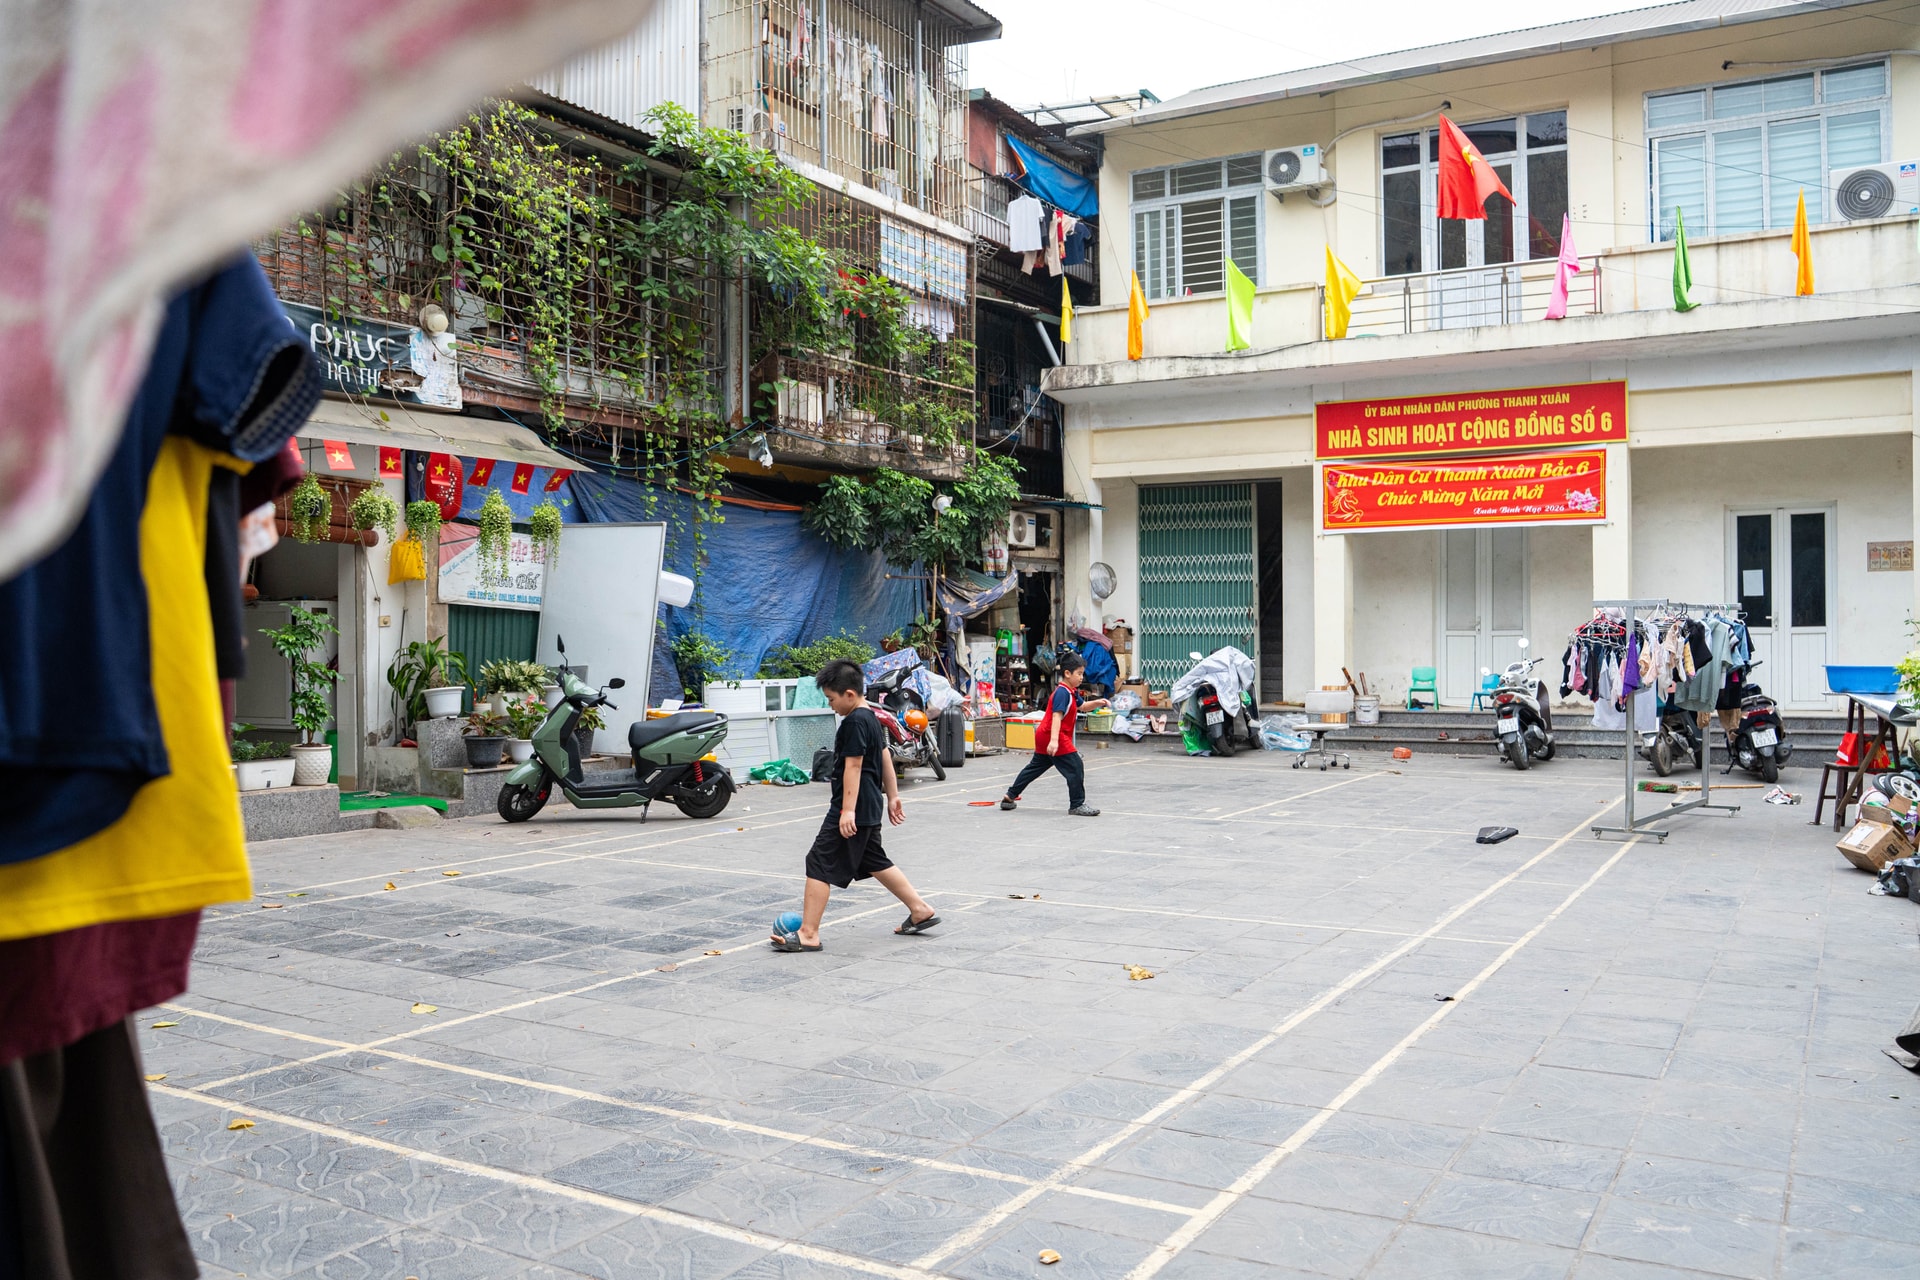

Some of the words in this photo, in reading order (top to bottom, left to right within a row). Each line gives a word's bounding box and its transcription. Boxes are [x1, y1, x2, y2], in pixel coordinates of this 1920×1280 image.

[1365, 404, 1378, 418] ỦY
[1380, 406, 1401, 417] BAN
[1403, 402, 1432, 415] NHÂN
[1434, 400, 1456, 413] DÂN
[1458, 396, 1500, 411] PHƯỜNG
[1503, 395, 1538, 408] THANH
[1540, 391, 1571, 405] XUÂN
[1328, 425, 1362, 449] NHÀ
[1367, 427, 1408, 447] SINH
[1412, 422, 1457, 447] HOẠT
[1461, 416, 1510, 444] CỘNG
[1515, 410, 1565, 438] ĐỒNG
[1570, 405, 1596, 435] SỐ
[1601, 411, 1613, 433] 6
[1371, 471, 1405, 486] Dân
[1408, 469, 1432, 484] Cư
[1434, 467, 1487, 483] Thanh
[1490, 464, 1536, 480] Xuân
[1540, 459, 1573, 478] Bắc
[1576, 460, 1590, 476] 6
[1377, 489, 1418, 507] Chúc
[1419, 488, 1467, 507] Mừng
[1469, 486, 1510, 502] Năm
[1512, 484, 1545, 500] Mới
[1544, 504, 1565, 513] 2026
